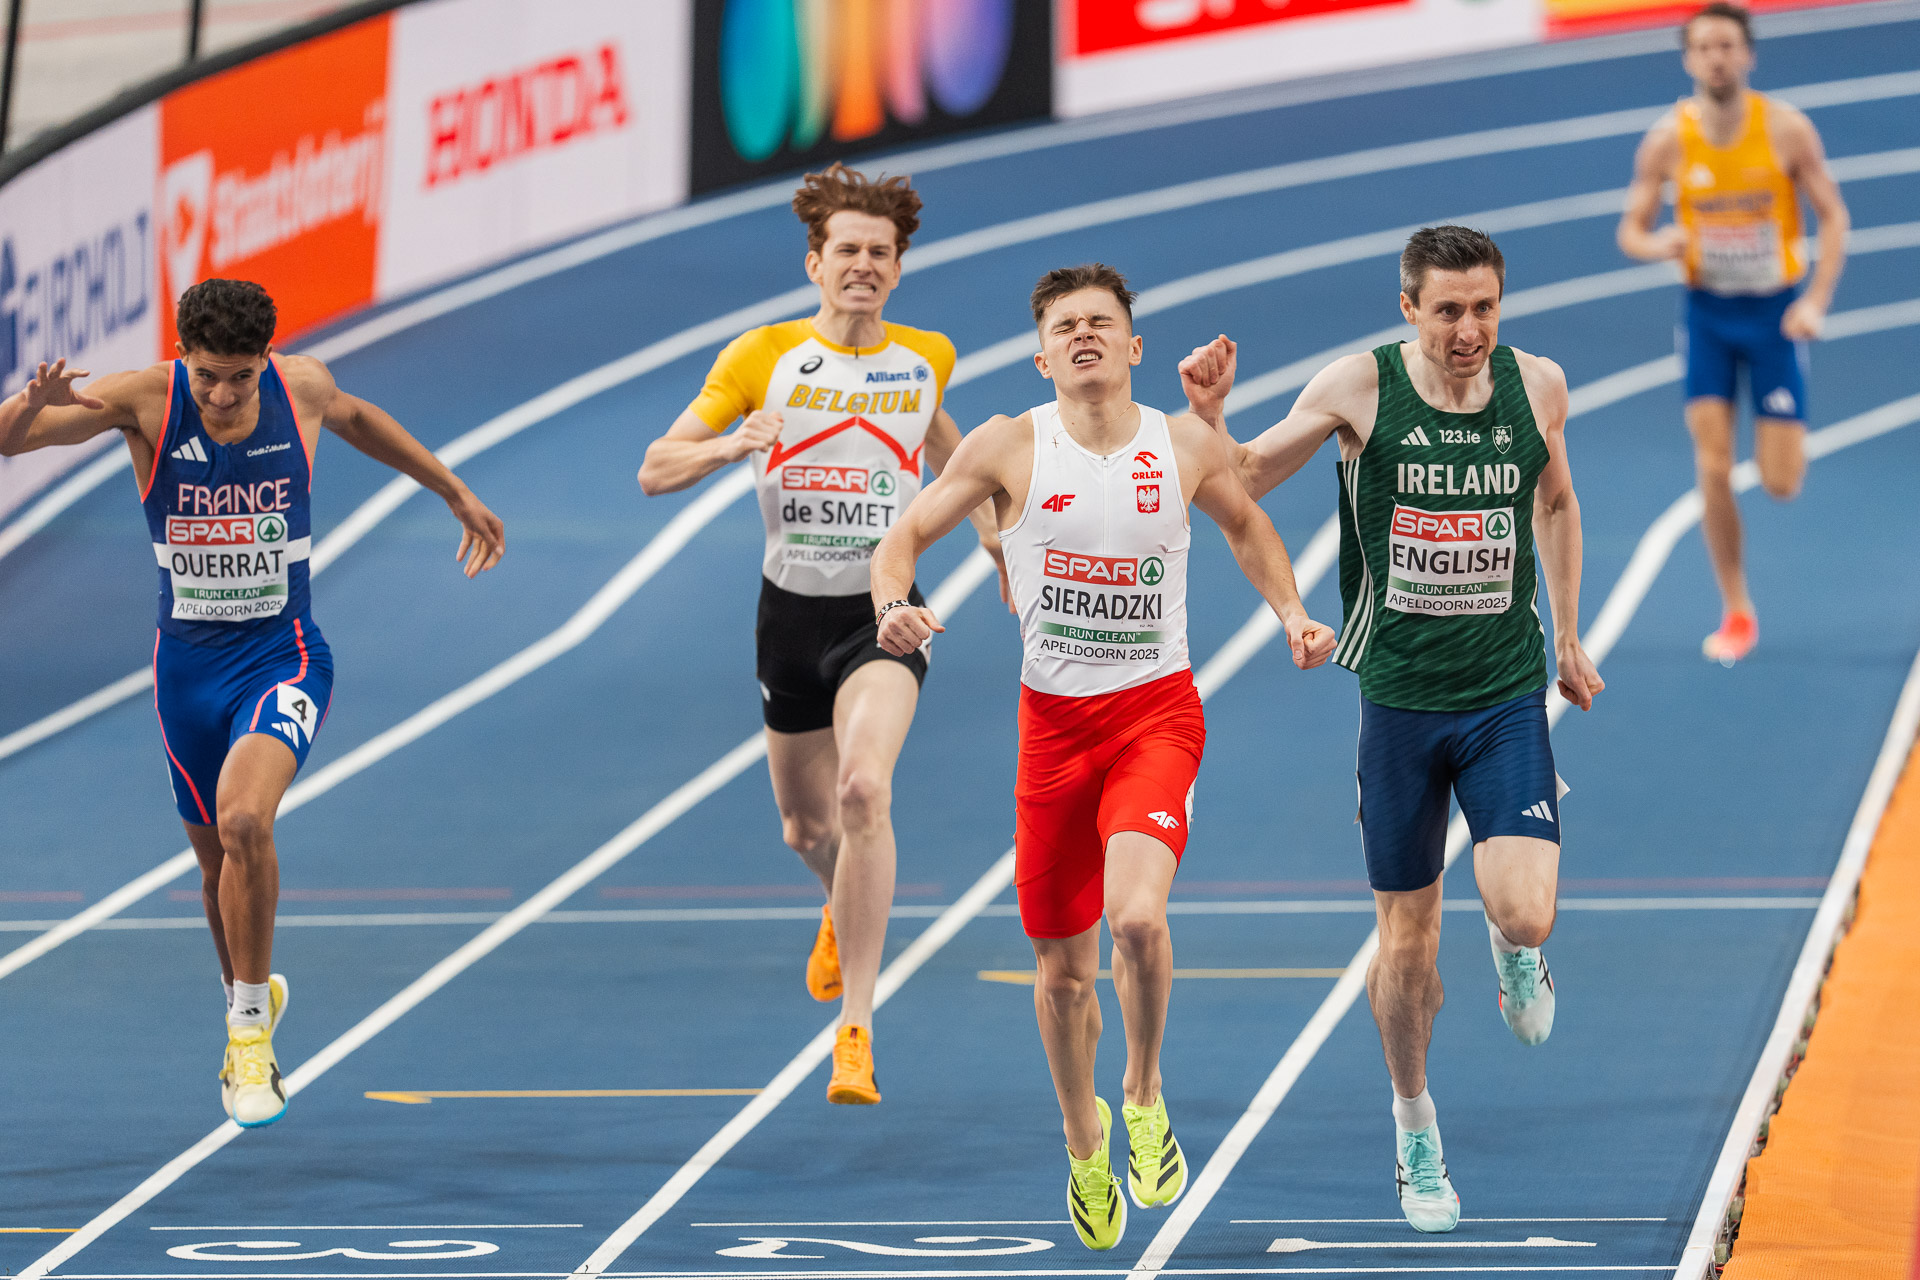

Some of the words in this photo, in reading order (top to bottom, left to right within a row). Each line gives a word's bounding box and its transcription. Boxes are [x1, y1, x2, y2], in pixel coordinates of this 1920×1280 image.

[424, 44, 629, 188] HONDA
[865, 371, 911, 383] Allianz
[786, 384, 922, 414] BELGIUM
[1439, 429, 1481, 444] 123.ie
[783, 468, 868, 491] SPAR
[1131, 470, 1163, 480] ORLEN
[1397, 463, 1521, 495] IRELAND
[178, 478, 291, 515] FRANCE
[1041, 494, 1076, 512] 4F
[782, 497, 812, 523] de
[820, 500, 895, 528] SMET
[171, 521, 253, 542] SPAR
[1395, 512, 1481, 539] SPAR
[172, 550, 284, 578] OUERRAT
[1047, 555, 1136, 582] SPAR
[1392, 543, 1511, 575] ENGLISH
[194, 589, 198, 598] I
[199, 589, 221, 600] RUN
[1411, 584, 1414, 592] I
[1417, 584, 1443, 594] RUN
[177, 602, 252, 616] APELDOORN
[254, 600, 283, 612] 2025
[1040, 585, 1162, 620] SIERADZKI
[1389, 593, 1474, 611] APELDOORN
[1476, 597, 1508, 609] 2025
[1063, 626, 1067, 635] I
[1069, 627, 1094, 640] RUN
[1040, 639, 1126, 660] APELDOORN
[1129, 648, 1160, 660] 2025
[292, 698, 308, 723] 4
[1147, 811, 1180, 829] 4F
